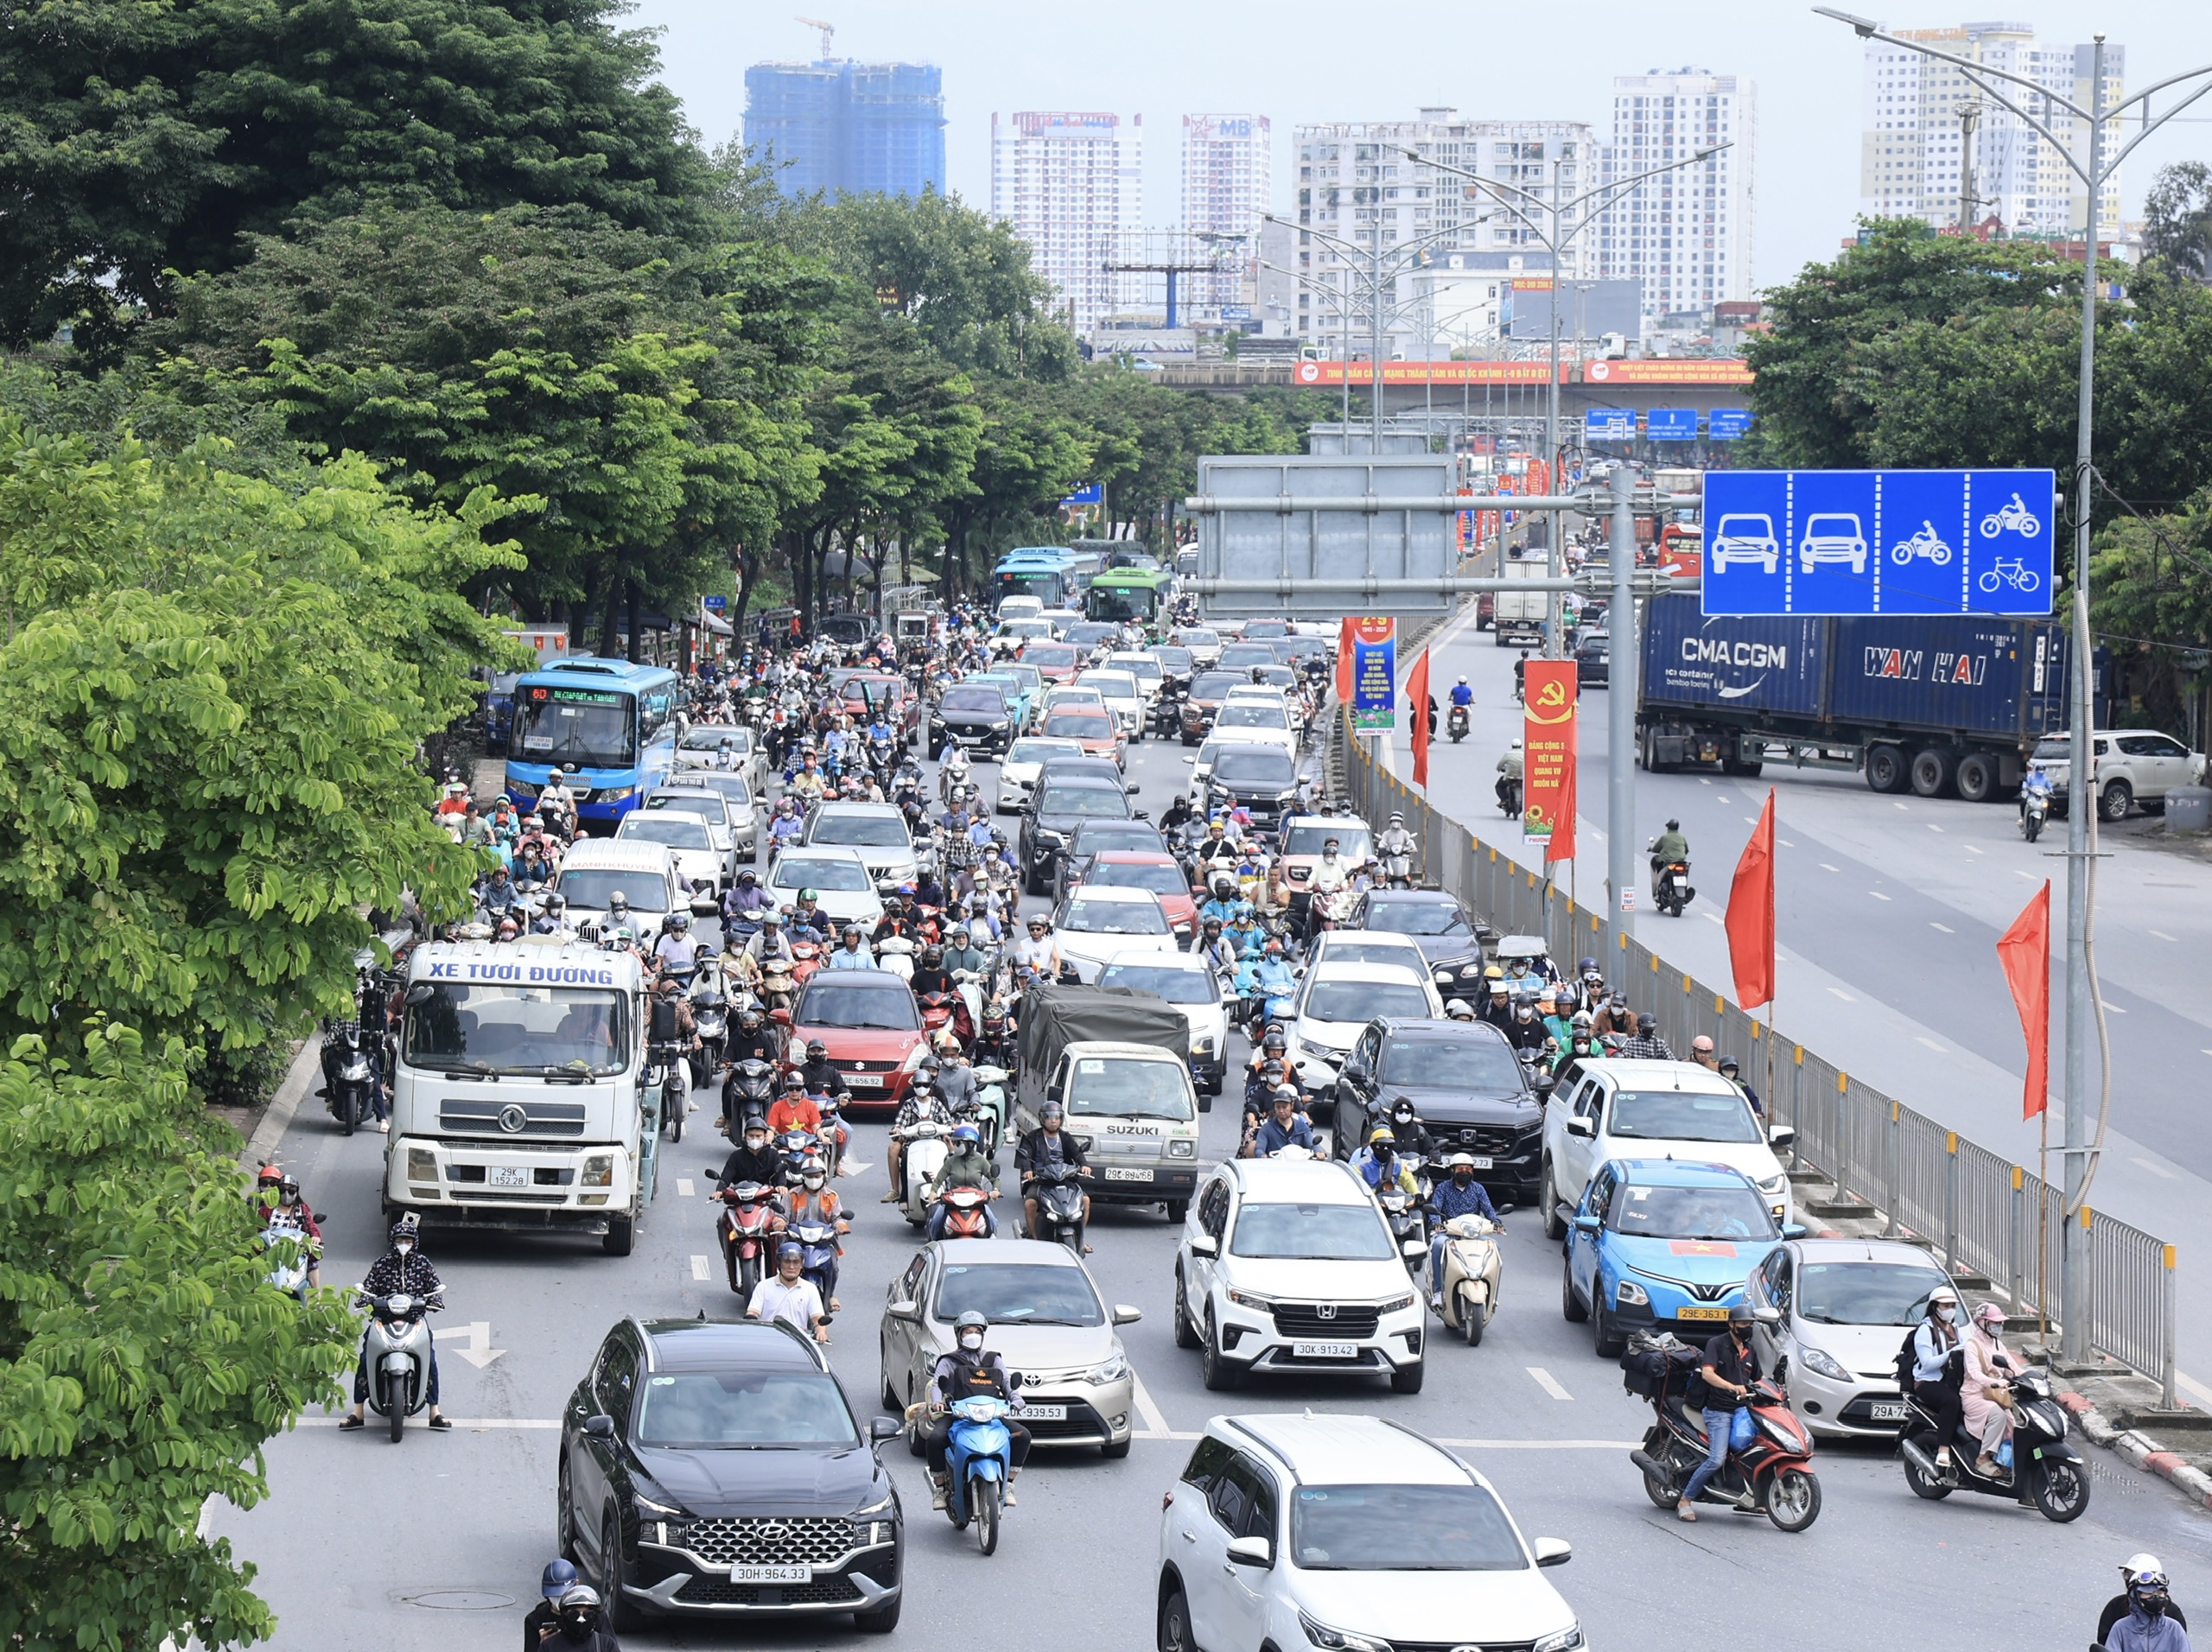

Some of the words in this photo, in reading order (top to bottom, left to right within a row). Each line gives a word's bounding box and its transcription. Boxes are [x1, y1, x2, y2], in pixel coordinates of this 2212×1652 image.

[1219, 120, 1250, 136] MB
[1681, 638, 1731, 664] CMA
[1734, 643, 1786, 669] CGM
[1865, 646, 1923, 680] WAN
[1931, 652, 1986, 685] HAI
[1529, 740, 1543, 750] ĐẢNG
[1545, 741, 1560, 751] CỘNG
[1537, 753, 1549, 764] VIỆT
[1550, 754, 1563, 763] NAM
[1534, 767, 1553, 776] QUANG
[429, 963, 459, 977] XE
[843, 1077, 880, 1085] 0E-656.92
[1107, 1125, 1159, 1135] SUZUKI
[501, 1167, 518, 1176] 29K
[1682, 1309, 1727, 1319] 29E-363.1
[1300, 1344, 1352, 1355] 30K-913.42
[1006, 1407, 1061, 1417] 0K-939.53
[1874, 1406, 1904, 1417] 29A-7
[738, 1568, 805, 1579] 30H-964.33
